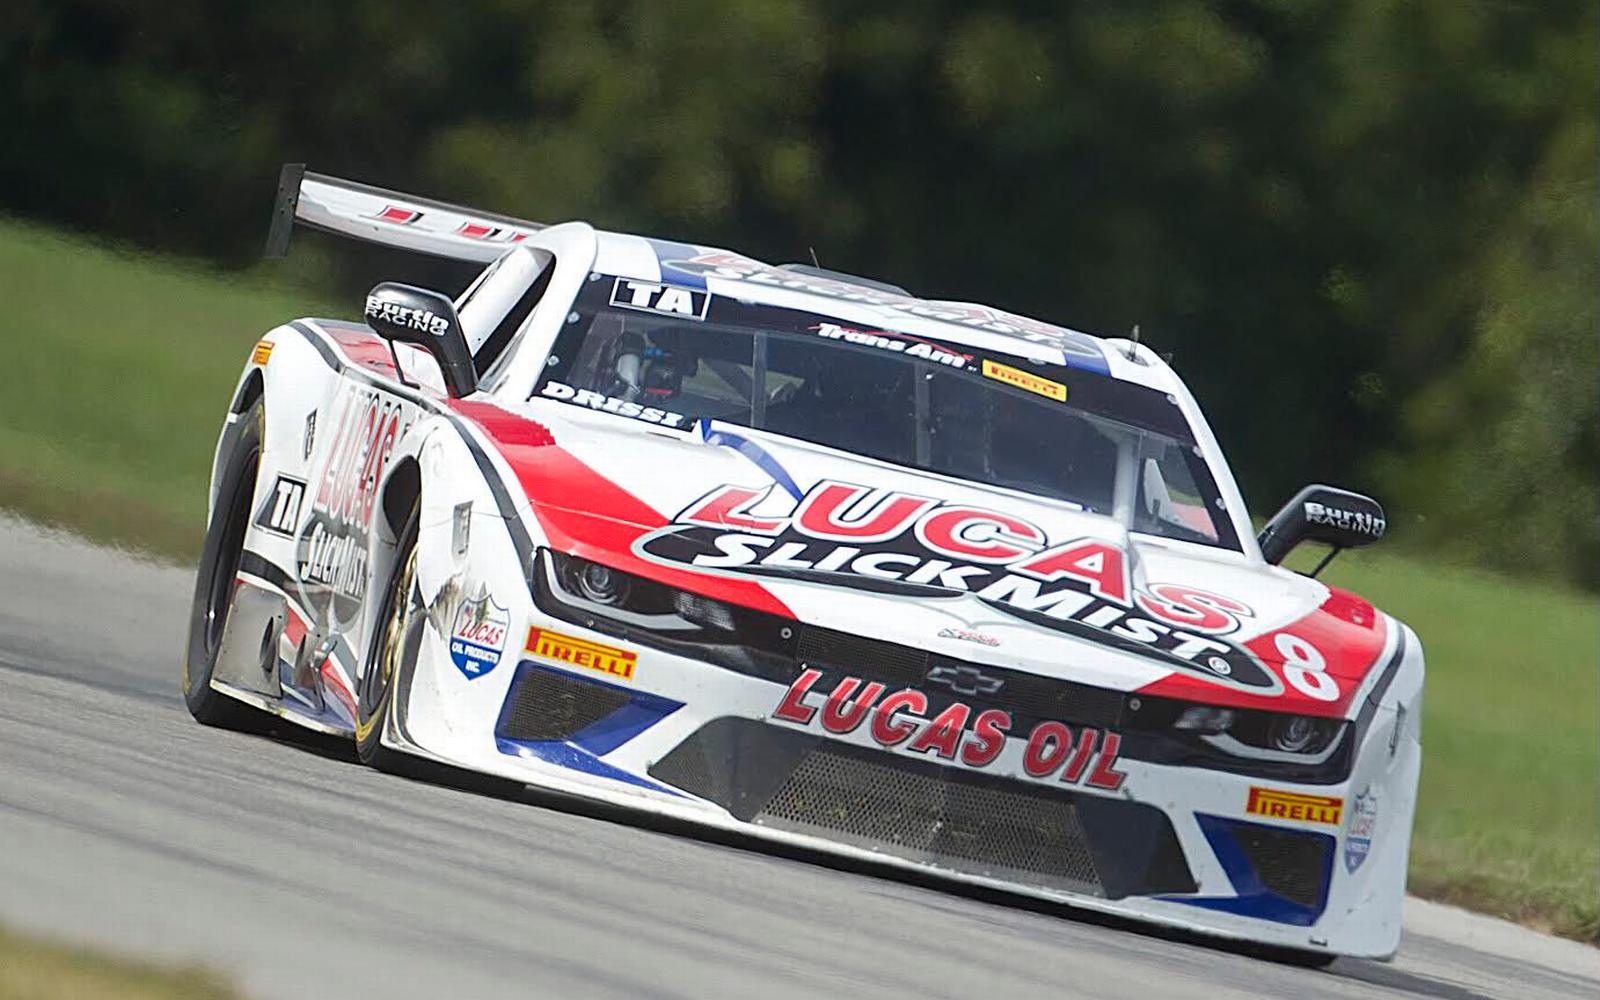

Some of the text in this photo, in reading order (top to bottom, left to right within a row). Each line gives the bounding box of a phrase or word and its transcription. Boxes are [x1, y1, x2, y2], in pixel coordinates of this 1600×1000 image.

[366, 295, 449, 330] Burtin
[626, 281, 694, 315] TA
[366, 306, 446, 336] RACING
[541, 380, 684, 426] DRISSI
[269, 479, 303, 533] TA
[1304, 502, 1386, 530] Burtin
[1306, 513, 1384, 537] RACING
[673, 479, 1254, 634] LUCAS
[692, 533, 1231, 660] SLICKMIST
[457, 618, 505, 646] LUCAS
[525, 625, 637, 679] PIRELLI
[1274, 633, 1340, 701] 8
[771, 668, 1128, 790] LUCAS OIL
[1246, 786, 1344, 825] PIRELLI
